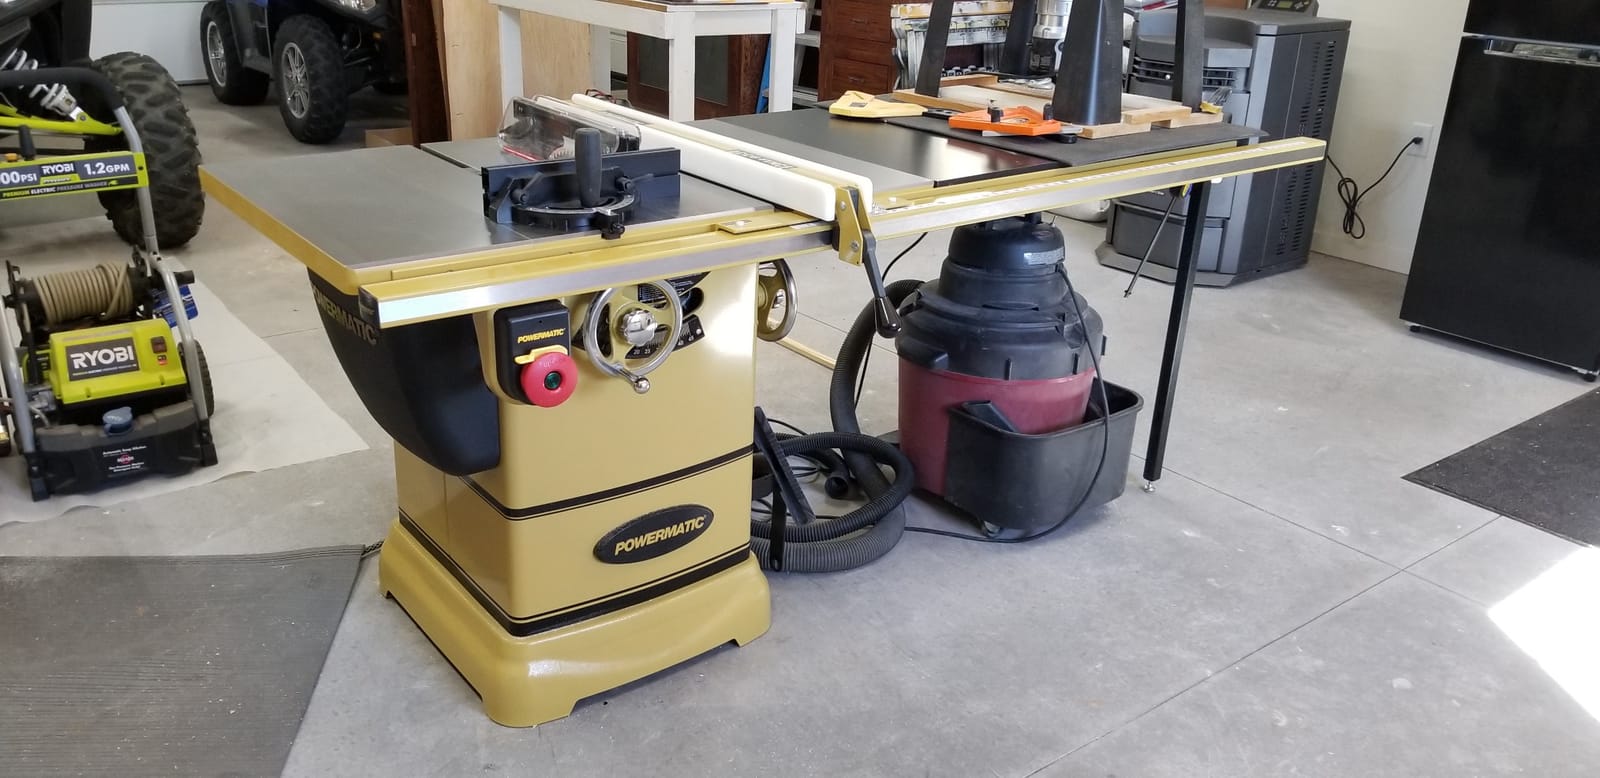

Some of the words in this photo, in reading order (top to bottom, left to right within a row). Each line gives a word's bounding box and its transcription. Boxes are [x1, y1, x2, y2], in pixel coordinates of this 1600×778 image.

[41, 162, 75, 175] RYOBI
[31, 185, 57, 195] ELECTRIC
[56, 183, 84, 193] PRESSURE
[310, 284, 377, 346] OWERMATIC
[517, 328, 565, 344] POWERMATIC
[69, 345, 135, 369] RYOBI
[614, 516, 706, 556] POWERMATIC
